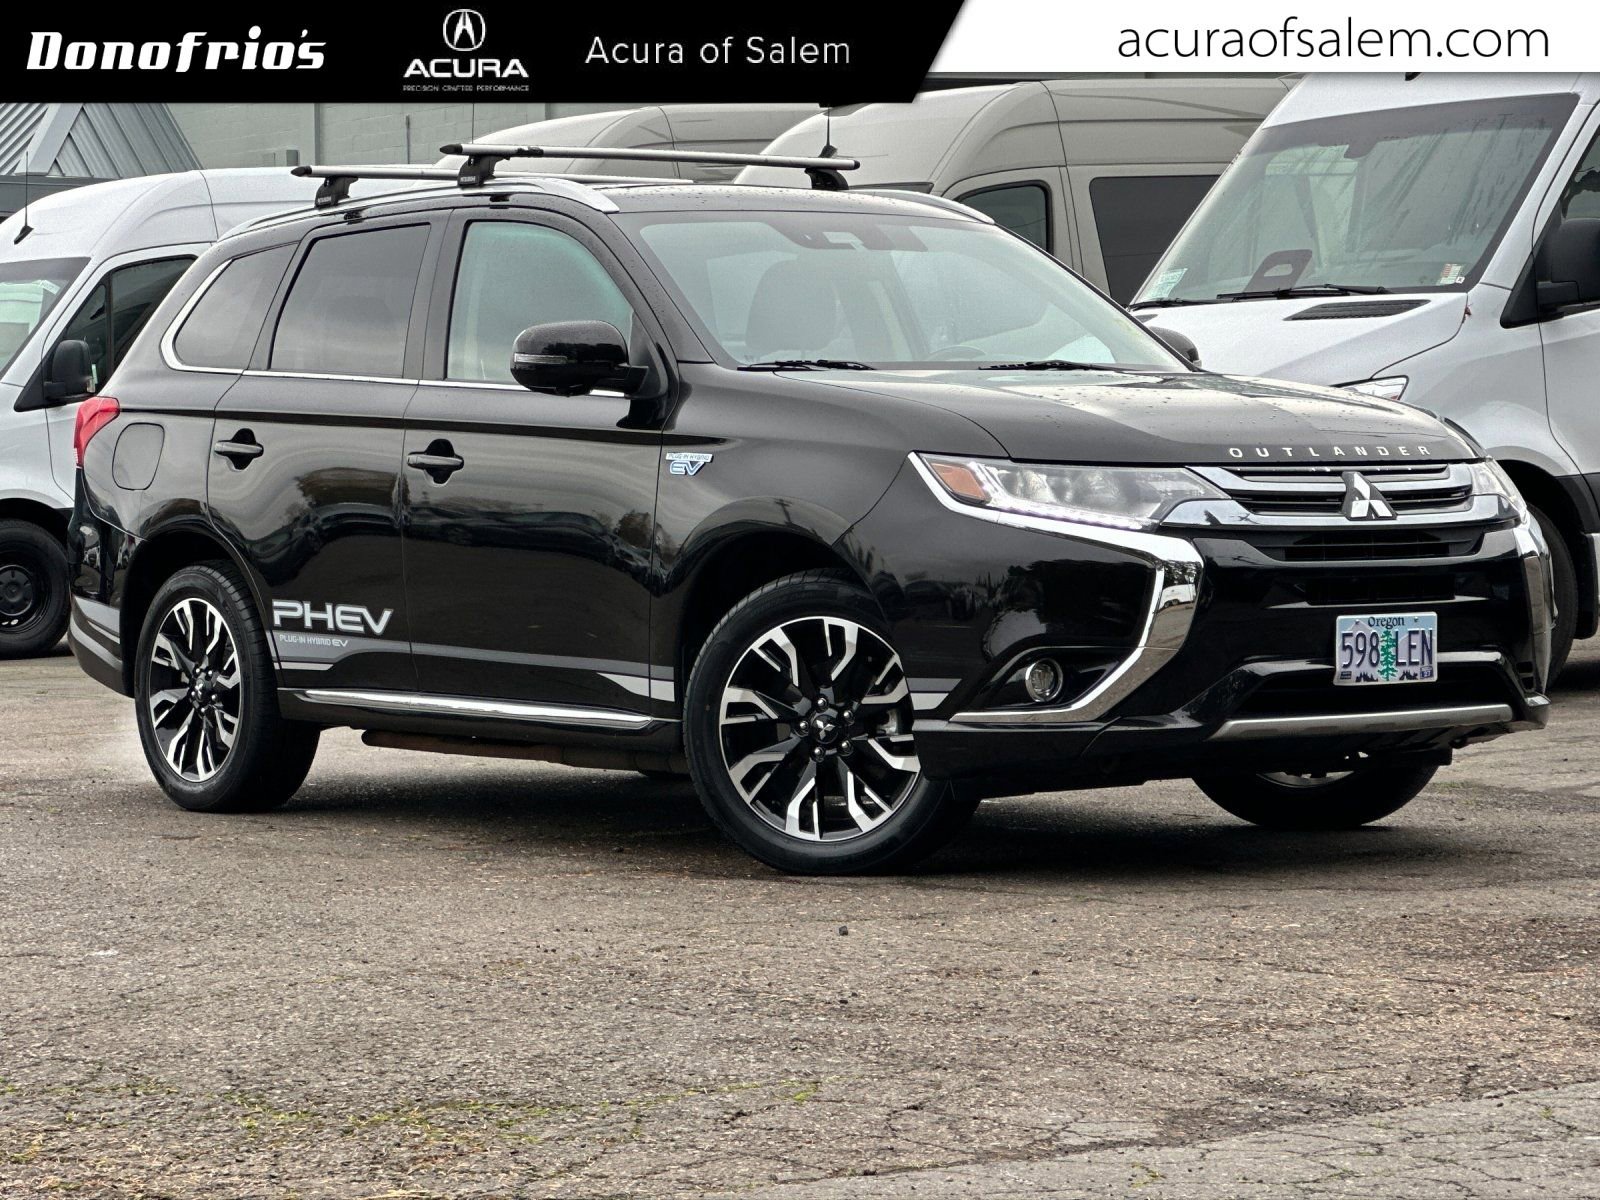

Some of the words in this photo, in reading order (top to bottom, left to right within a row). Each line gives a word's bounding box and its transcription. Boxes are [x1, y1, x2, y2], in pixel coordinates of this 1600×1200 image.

[1229, 446, 1430, 458] OUTLANDER
[670, 460, 705, 476] EV
[272, 599, 394, 635] PHEV
[1368, 616, 1405, 629] Oregon
[279, 634, 306, 644] PLUG-IN
[307, 636, 332, 646] HYBRID
[332, 638, 349, 647] EV
[1341, 630, 1381, 669] 598
[1395, 627, 1434, 666] LEN
